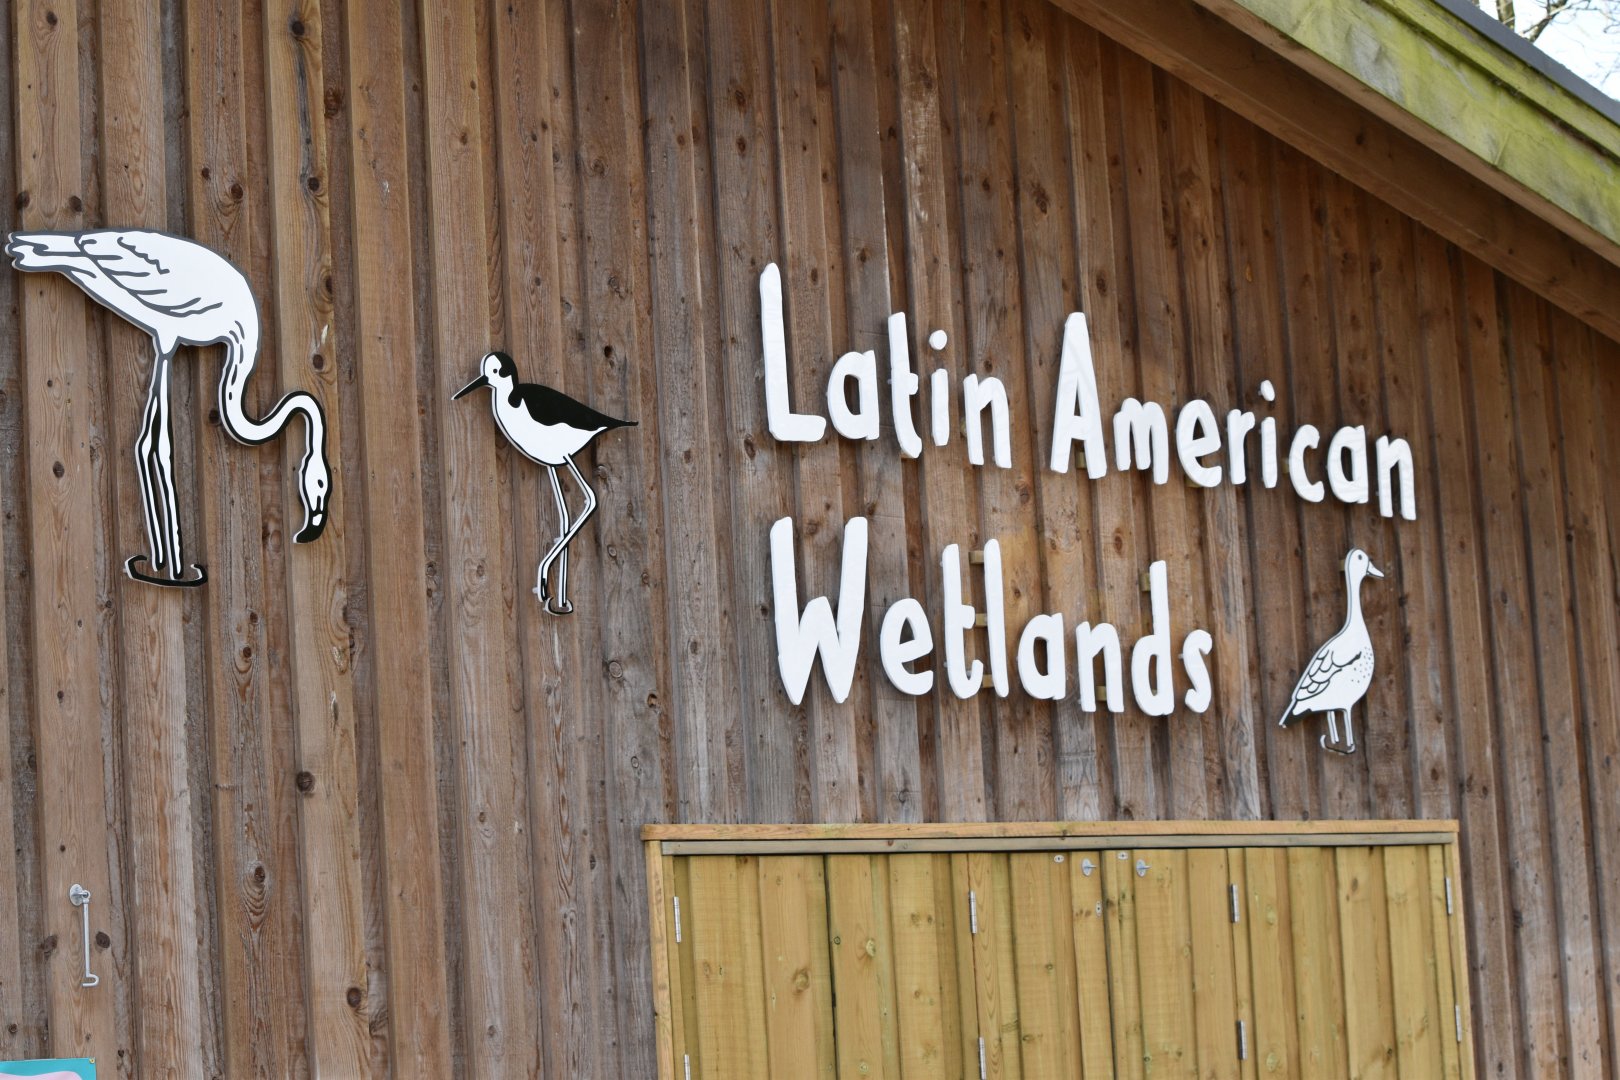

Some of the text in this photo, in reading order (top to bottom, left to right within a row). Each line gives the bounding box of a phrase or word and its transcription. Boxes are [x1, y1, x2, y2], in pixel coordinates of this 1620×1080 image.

[759, 262, 1416, 521] Latin American
[769, 516, 1214, 716] Wetlands
